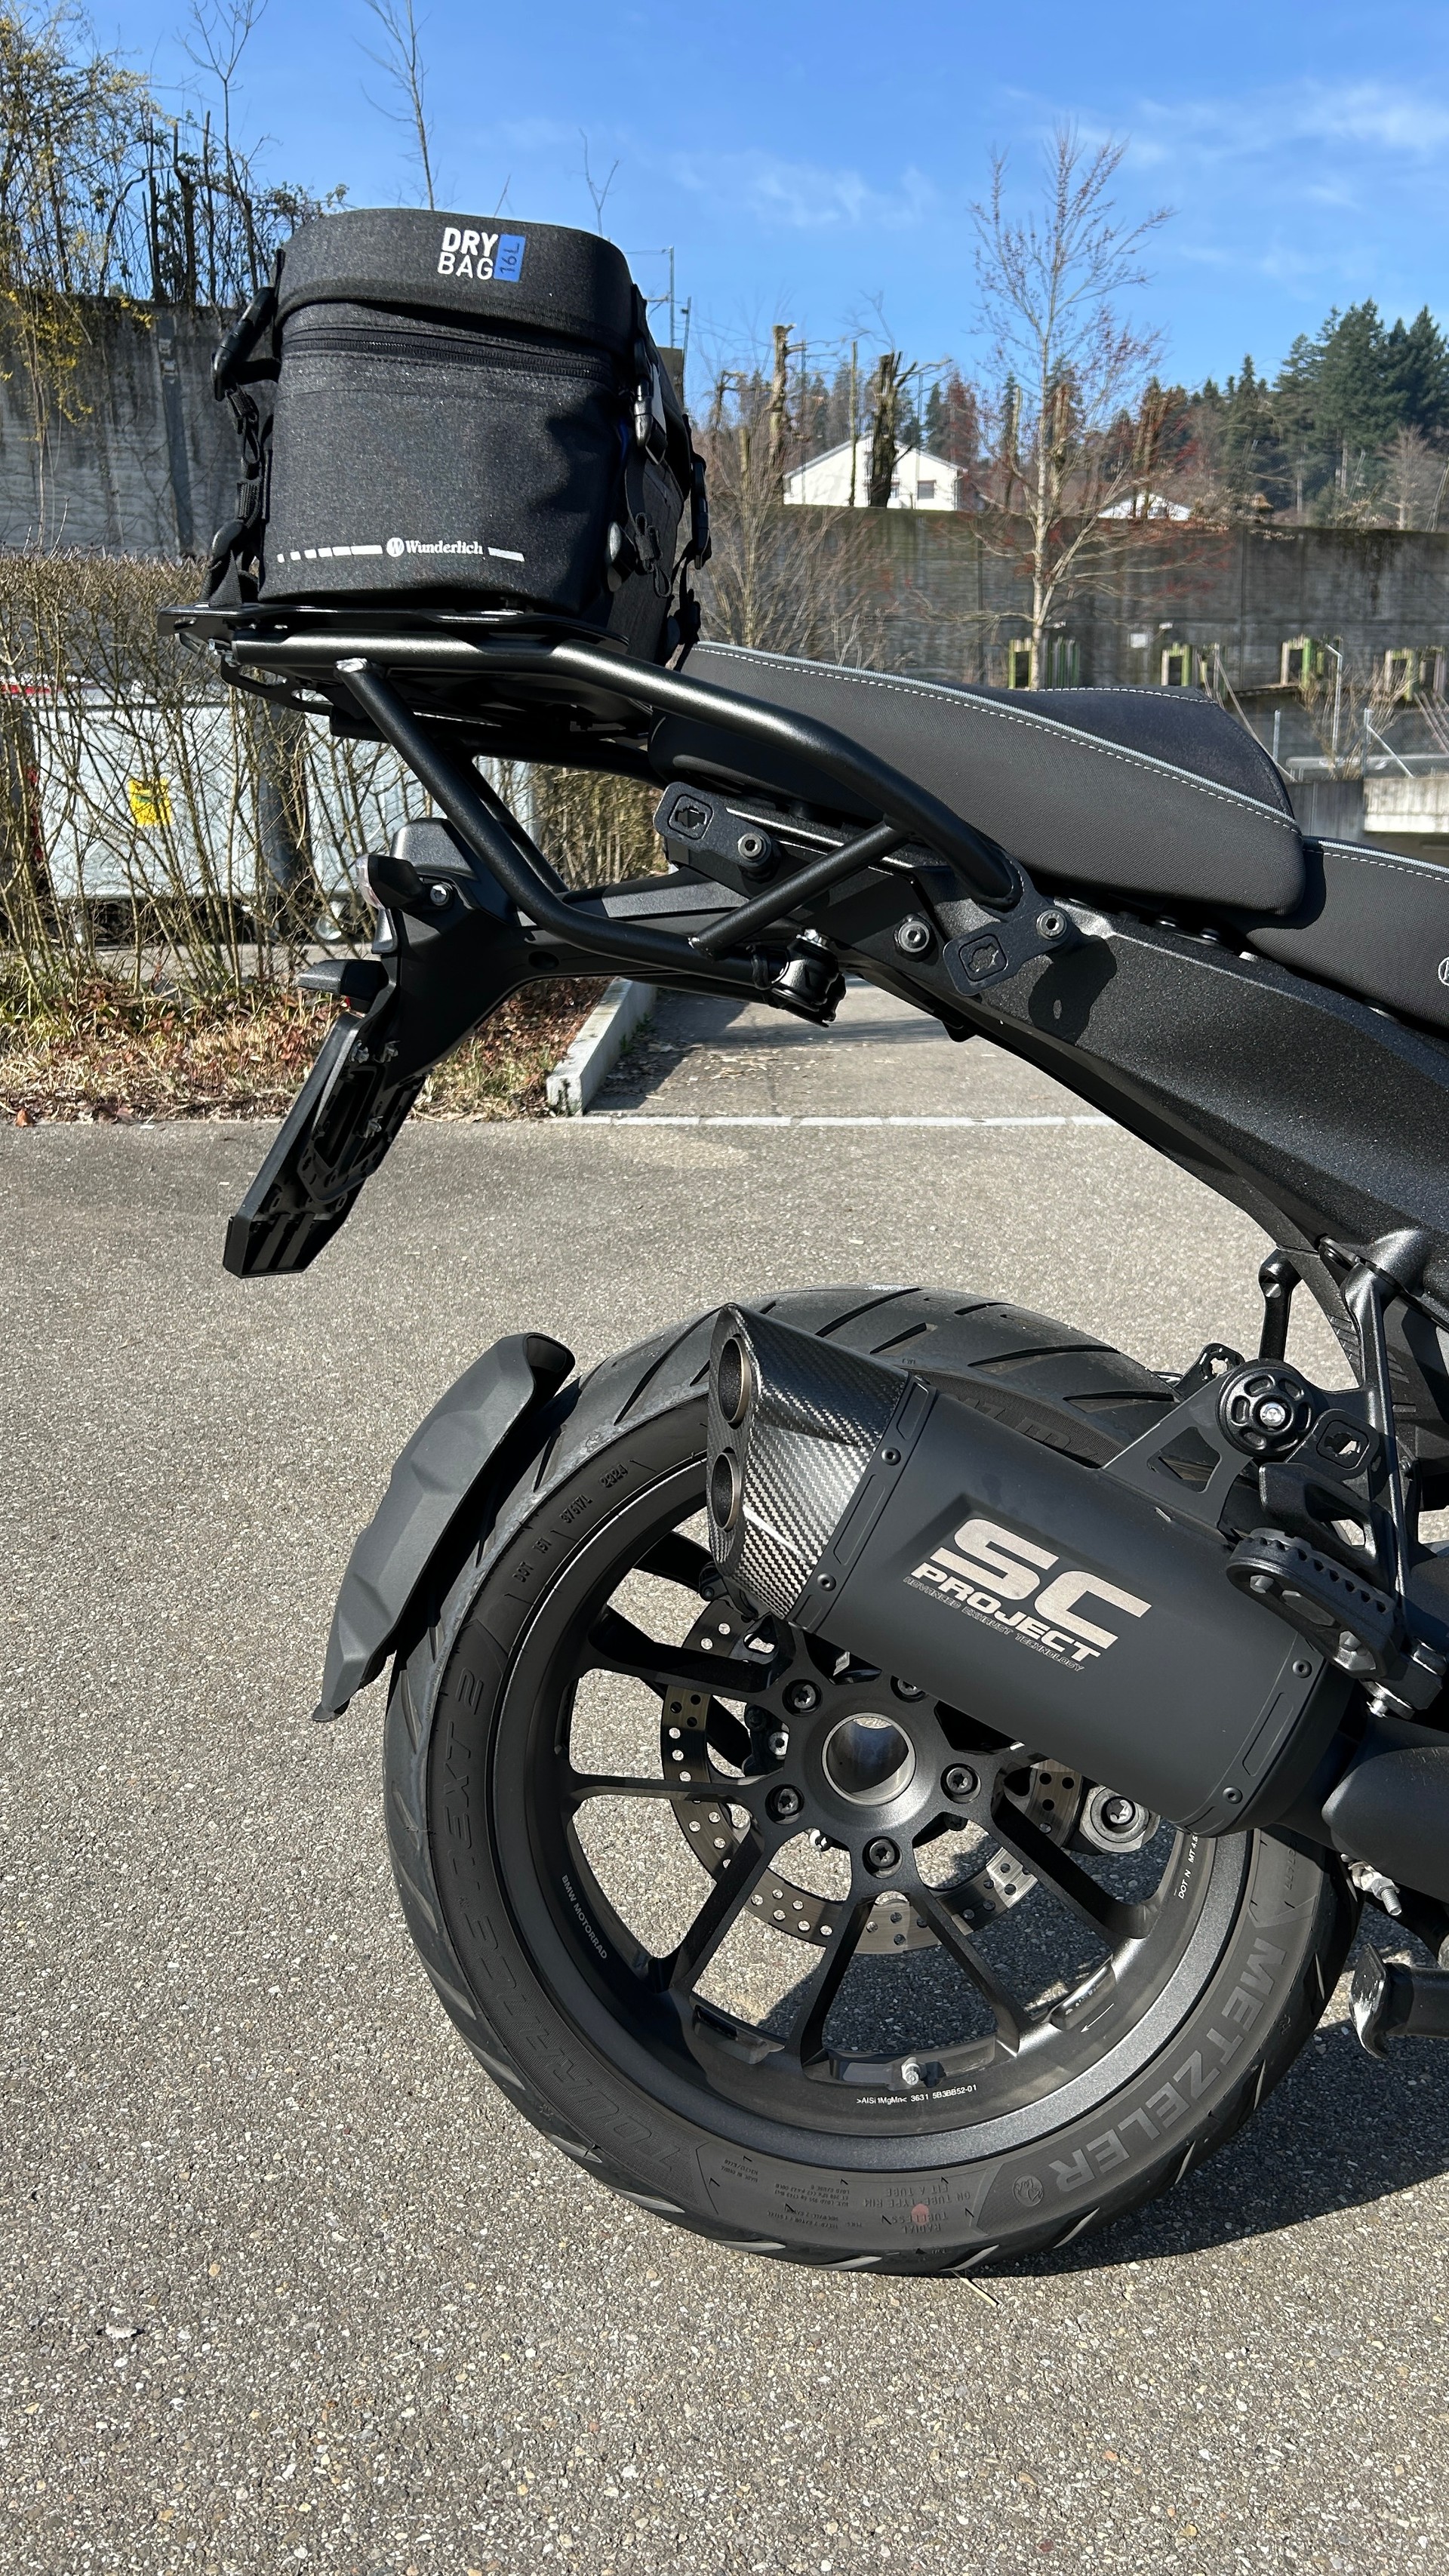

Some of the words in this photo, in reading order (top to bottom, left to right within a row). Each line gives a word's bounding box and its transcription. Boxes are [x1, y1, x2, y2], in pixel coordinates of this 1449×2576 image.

[441, 227, 499, 257] DRY
[438, 251, 494, 280] BAG
[500, 242, 520, 274] 16L
[405, 540, 484, 555] Wunderlich
[930, 1518, 1152, 1650] SC
[903, 1576, 961, 1610] ADVANCED
[961, 1605, 1014, 1636] EXHAUST
[1014, 1633, 1085, 1673] TECHNOLOGY
[910, 1562, 1101, 1663] PROJECT
[454, 1667, 485, 1715] 2
[1187, 1848, 1196, 1864] MT
[1184, 1869, 1192, 1879] N
[1177, 1879, 1188, 1900] DOT
[561, 1874, 577, 1902] BMW
[574, 1902, 608, 1959] MOTORRAD
[1048, 1937, 1287, 2192] METZELER
[910, 2092, 929, 2103] 3631
[884, 2187, 915, 2198] TUBE
[901, 2222, 942, 2234] RADIAL
